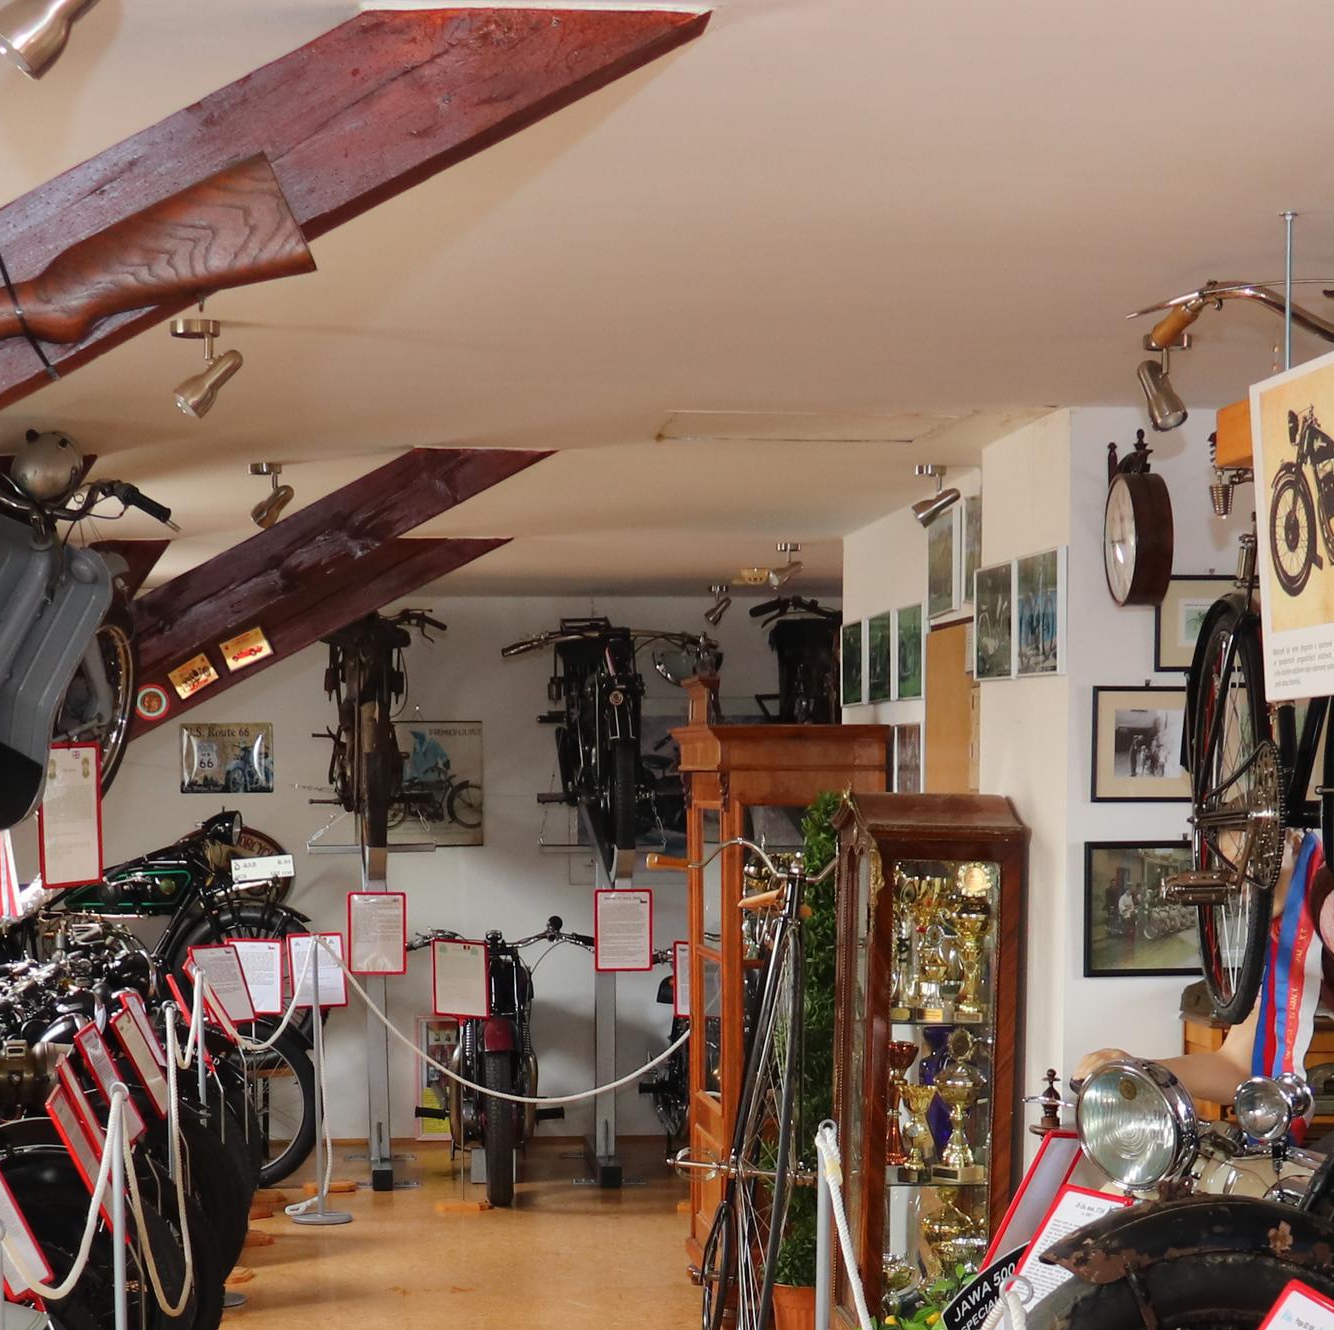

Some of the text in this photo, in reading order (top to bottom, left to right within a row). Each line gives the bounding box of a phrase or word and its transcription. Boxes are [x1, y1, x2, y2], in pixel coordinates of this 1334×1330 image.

[208, 727, 236, 737] Route
[239, 727, 250, 736] 66
[199, 759, 214, 768] 66
[954, 1263, 1015, 1322] JAWA 500
